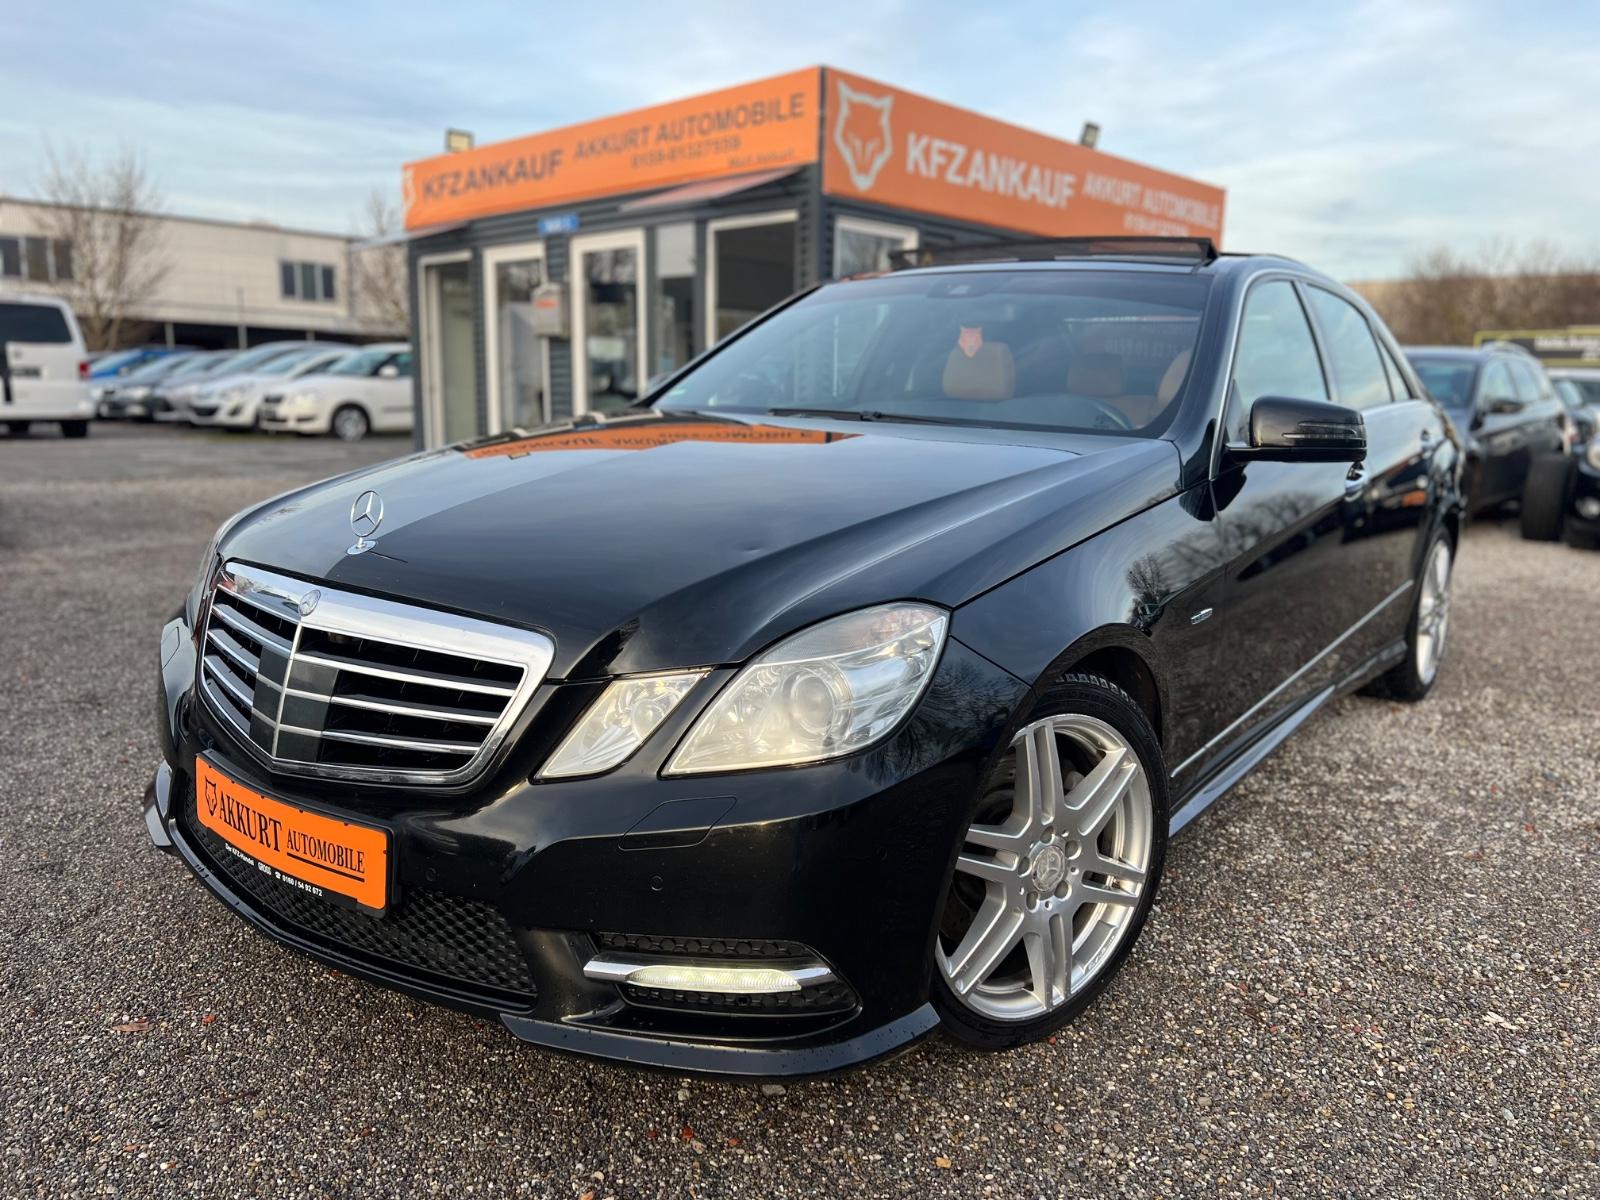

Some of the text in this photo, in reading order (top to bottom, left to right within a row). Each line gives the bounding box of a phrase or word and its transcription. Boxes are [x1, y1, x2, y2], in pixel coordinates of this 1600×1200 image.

[422, 93, 804, 200] KFZANKAUF AKKURT AUTOMOBILE
[906, 130, 1077, 210] KFZANKAUF
[219, 791, 365, 874] AKKURT AUTOMOBILE
